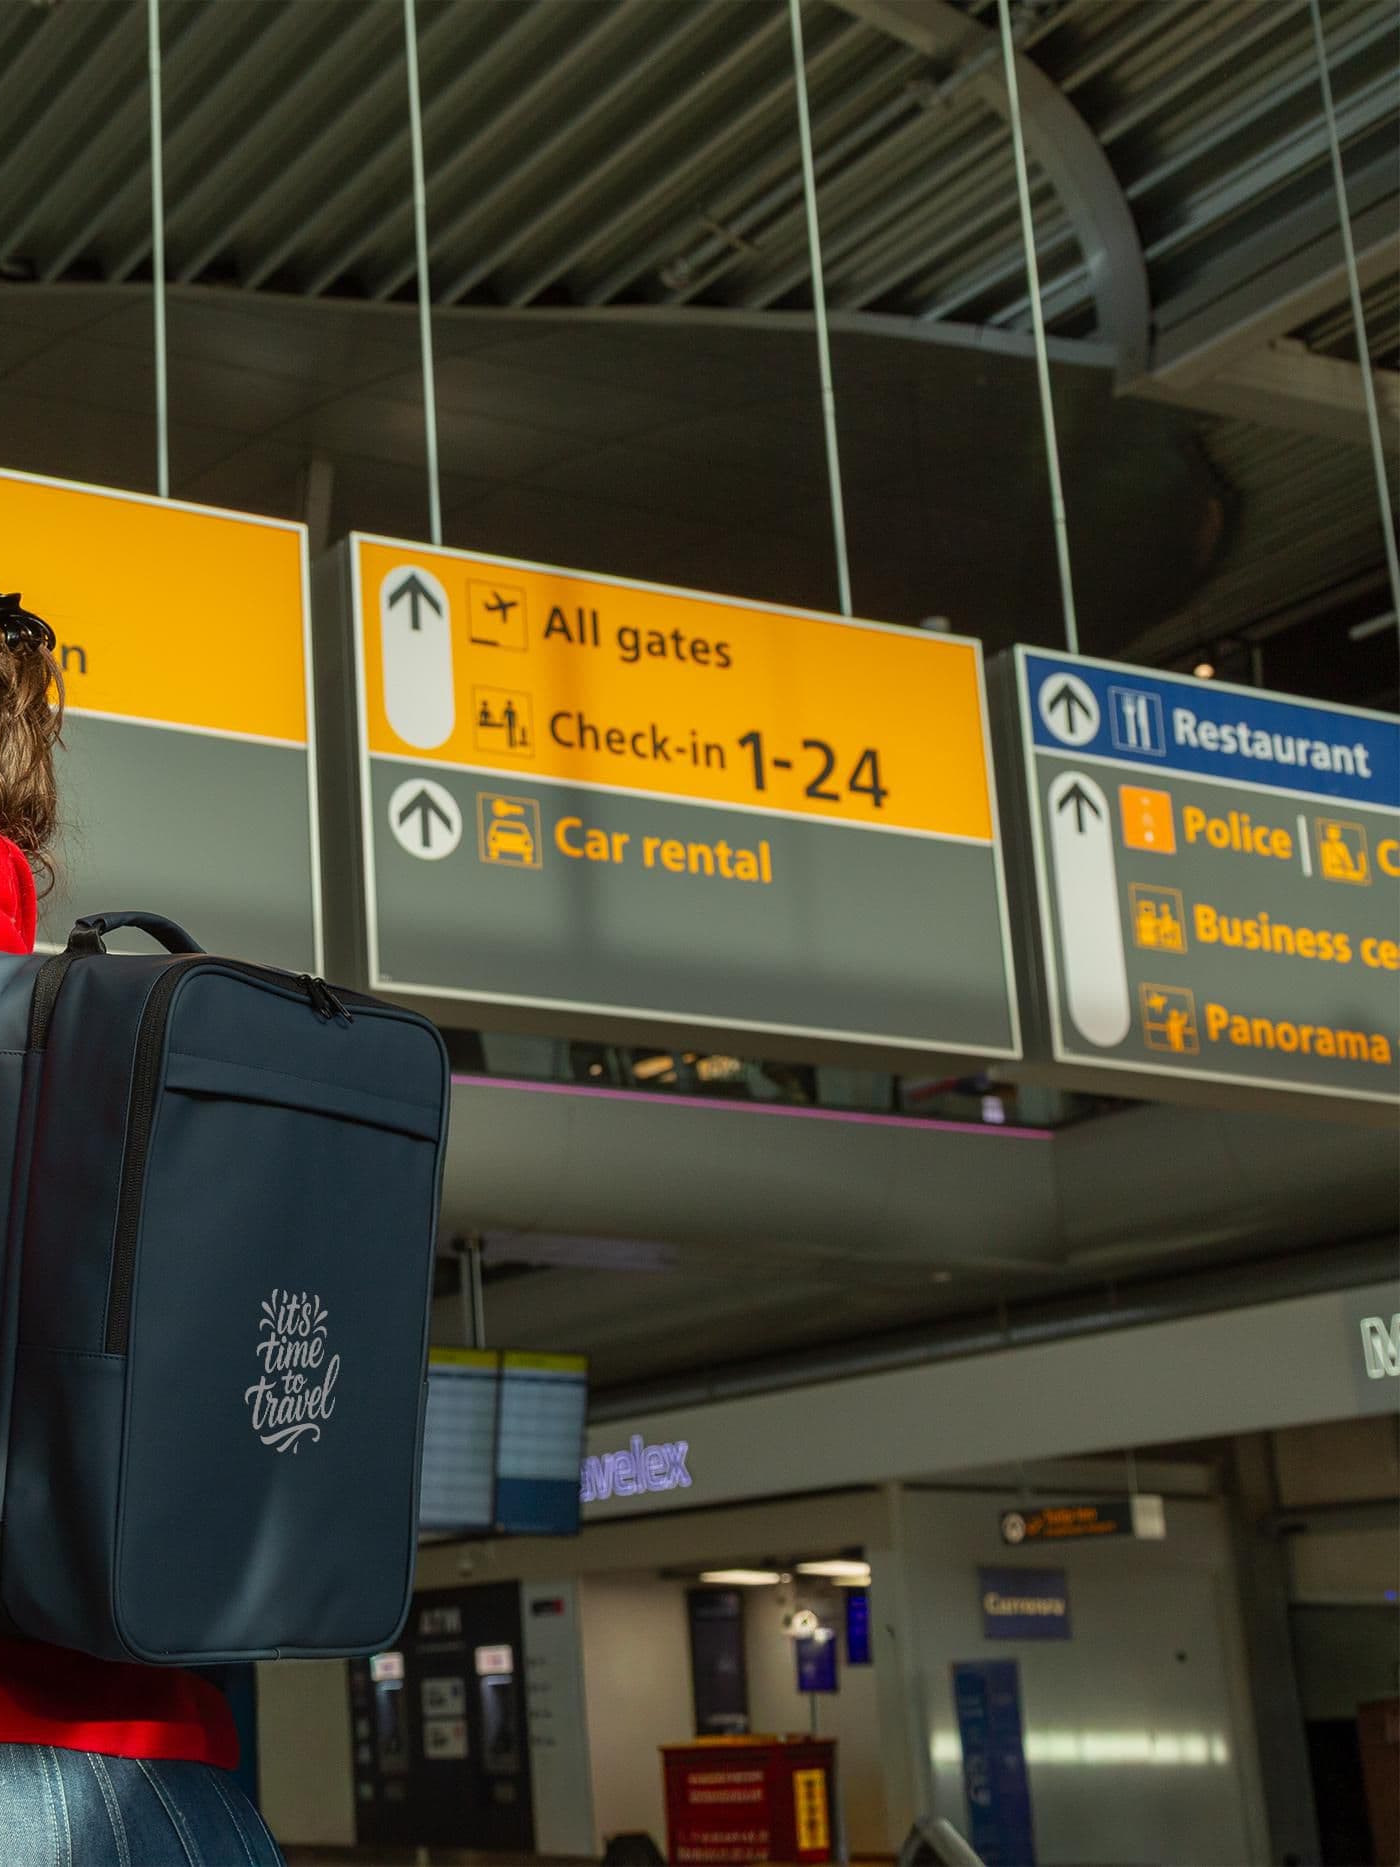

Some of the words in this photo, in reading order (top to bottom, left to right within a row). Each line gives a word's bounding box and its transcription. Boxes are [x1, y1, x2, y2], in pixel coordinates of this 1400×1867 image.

[544, 605, 599, 646] All
[617, 626, 732, 669] gates
[550, 711, 726, 769] Check-in
[737, 730, 888, 808] 1-24
[1173, 708, 1372, 778] Restaurant
[553, 816, 630, 864] Car
[642, 836, 773, 884] rental
[1182, 805, 1293, 860] Police
[1193, 903, 1353, 965] Business
[1205, 1003, 1392, 1065] Panorama
[256, 1332, 325, 1374] time
[281, 1370, 308, 1394] to
